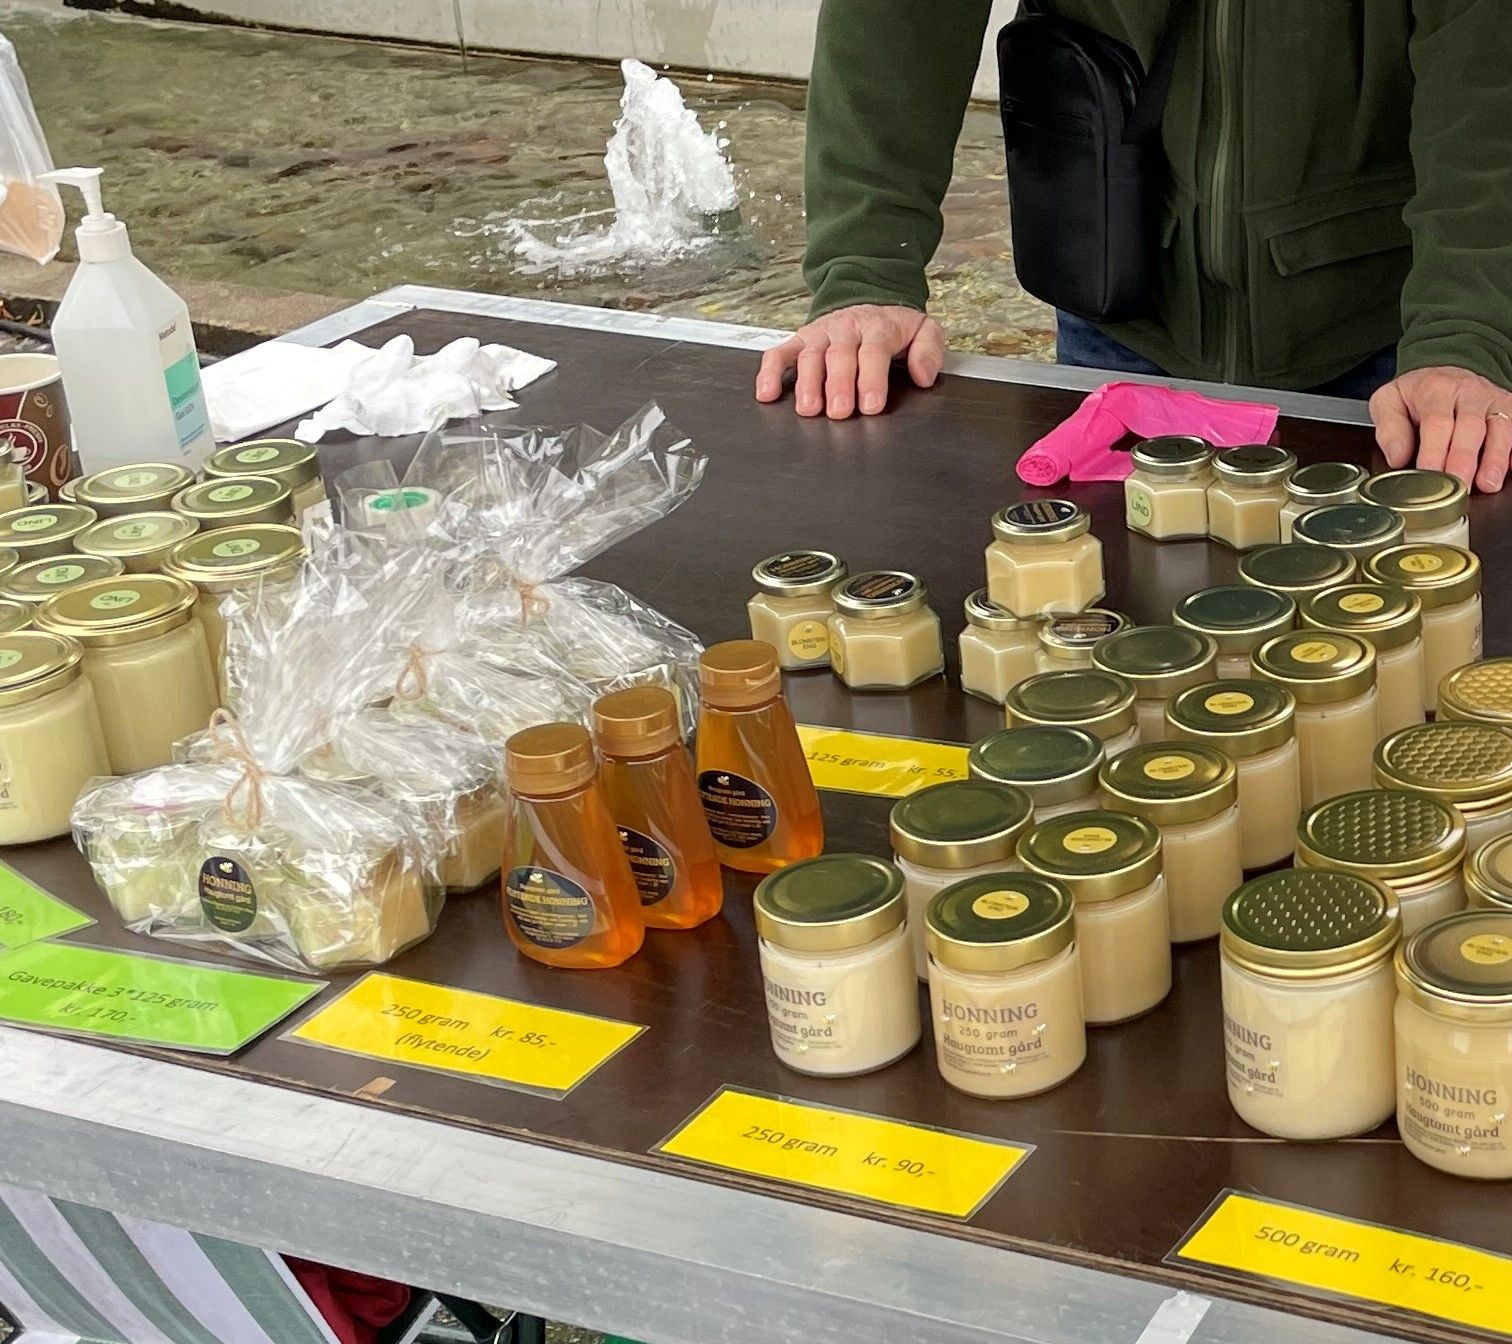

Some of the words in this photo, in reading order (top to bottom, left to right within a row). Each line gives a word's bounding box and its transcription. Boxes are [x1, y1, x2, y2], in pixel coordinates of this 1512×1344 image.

[806, 751, 840, 764] 125
[840, 756, 886, 769] gram
[8, 970, 107, 997] Gavepakke
[166, 996, 219, 1012] gram
[87, 1007, 136, 1024] 170,-
[942, 999, 1039, 1025] HONNING
[380, 1003, 420, 1022] 250
[418, 1012, 470, 1032] gram
[489, 1025, 513, 1043] kr.
[518, 1030, 559, 1050] 85,-
[985, 1029, 1018, 1041] gram
[395, 1031, 492, 1064] (flytende)
[1008, 1037, 1043, 1057] gård
[1406, 1066, 1498, 1106] HONNING
[1444, 1107, 1476, 1121] gram
[1464, 1124, 1500, 1140] gård
[741, 1124, 782, 1145] 250
[781, 1135, 839, 1158] gram
[862, 1150, 887, 1171] kr.
[892, 1159, 936, 1179] 90,-
[1253, 1225, 1302, 1248] 500
[1299, 1237, 1361, 1264] gram
[1388, 1257, 1416, 1277] kr.
[1424, 1266, 1485, 1293] 160,-
